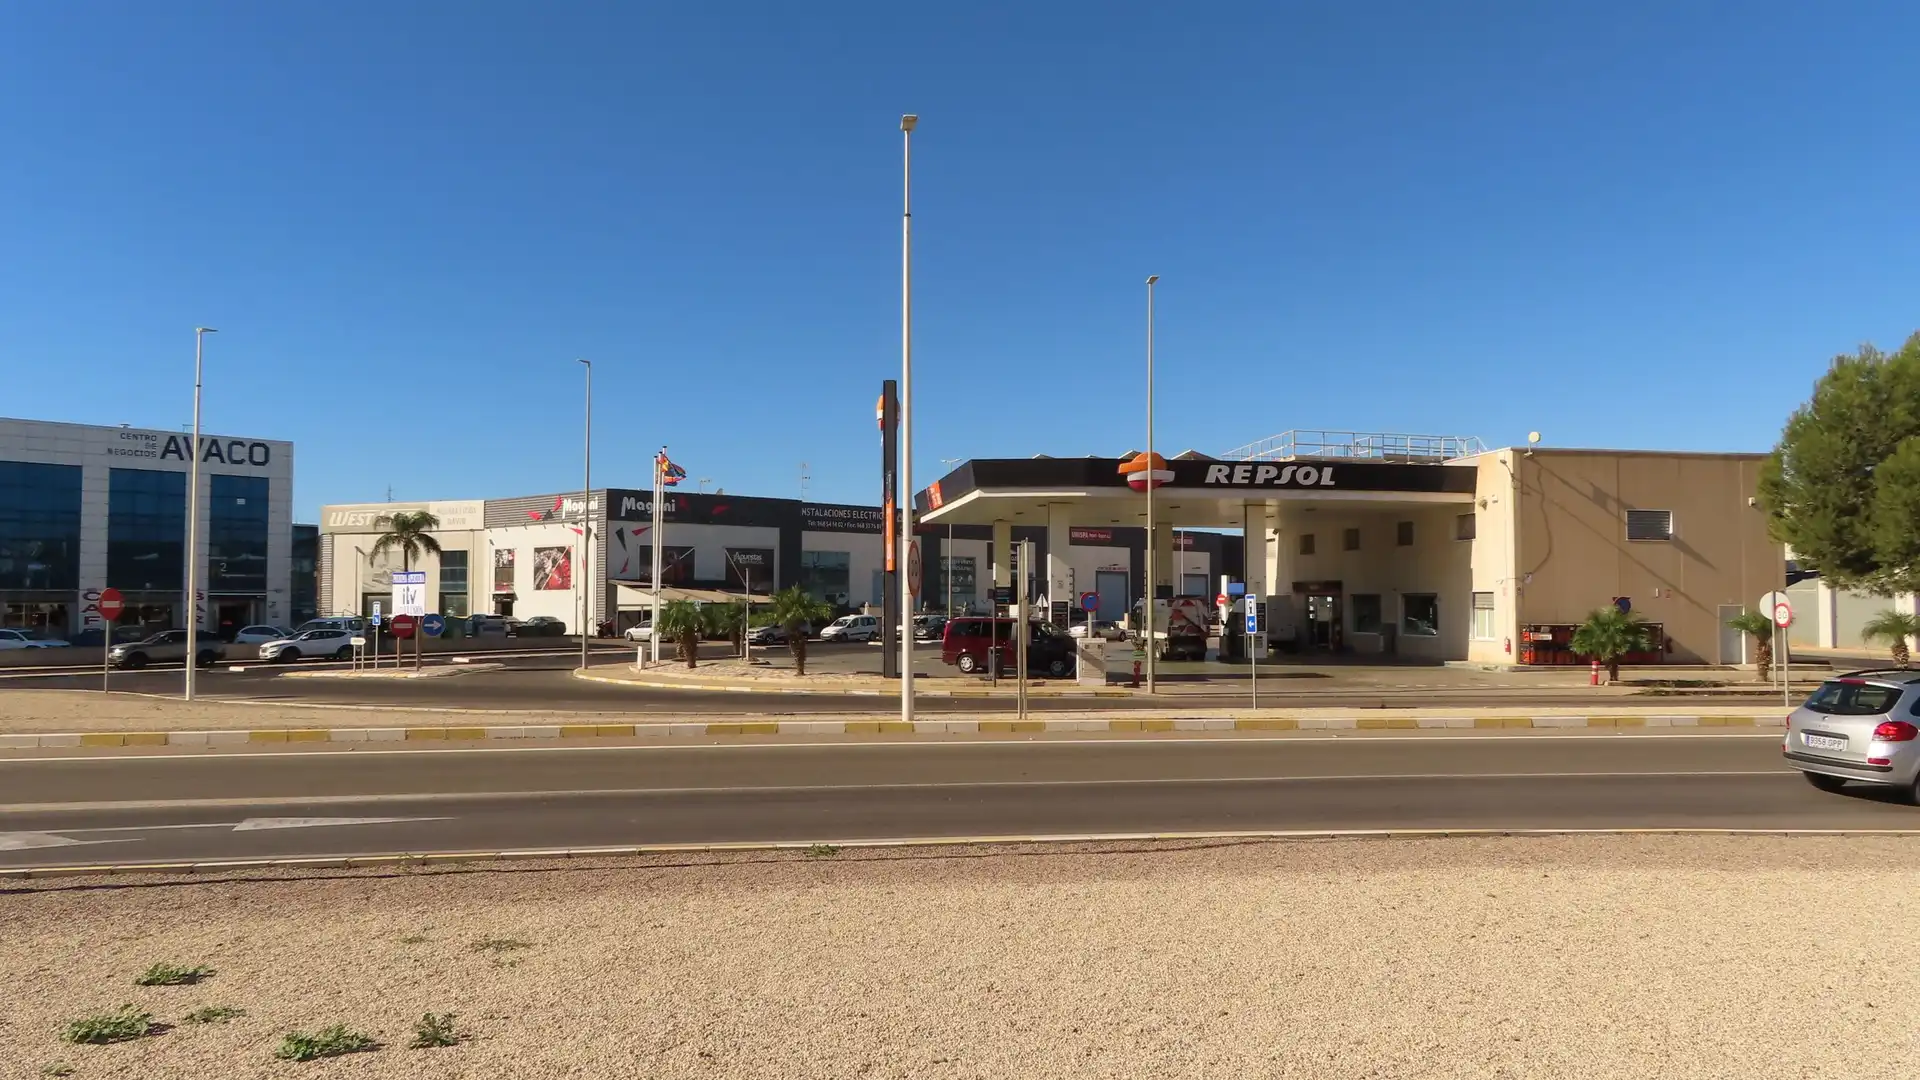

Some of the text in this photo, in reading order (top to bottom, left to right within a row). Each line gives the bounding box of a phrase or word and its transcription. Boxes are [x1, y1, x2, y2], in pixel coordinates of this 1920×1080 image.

[120, 432, 157, 442] CENTRO
[144, 442, 157, 450] DE
[107, 448, 157, 458] NEGOCIOS
[160, 436, 270, 466] AVACO
[1204, 464, 1336, 486] REPSOL
[561, 496, 598, 519] Magni
[621, 497, 676, 517] Magni
